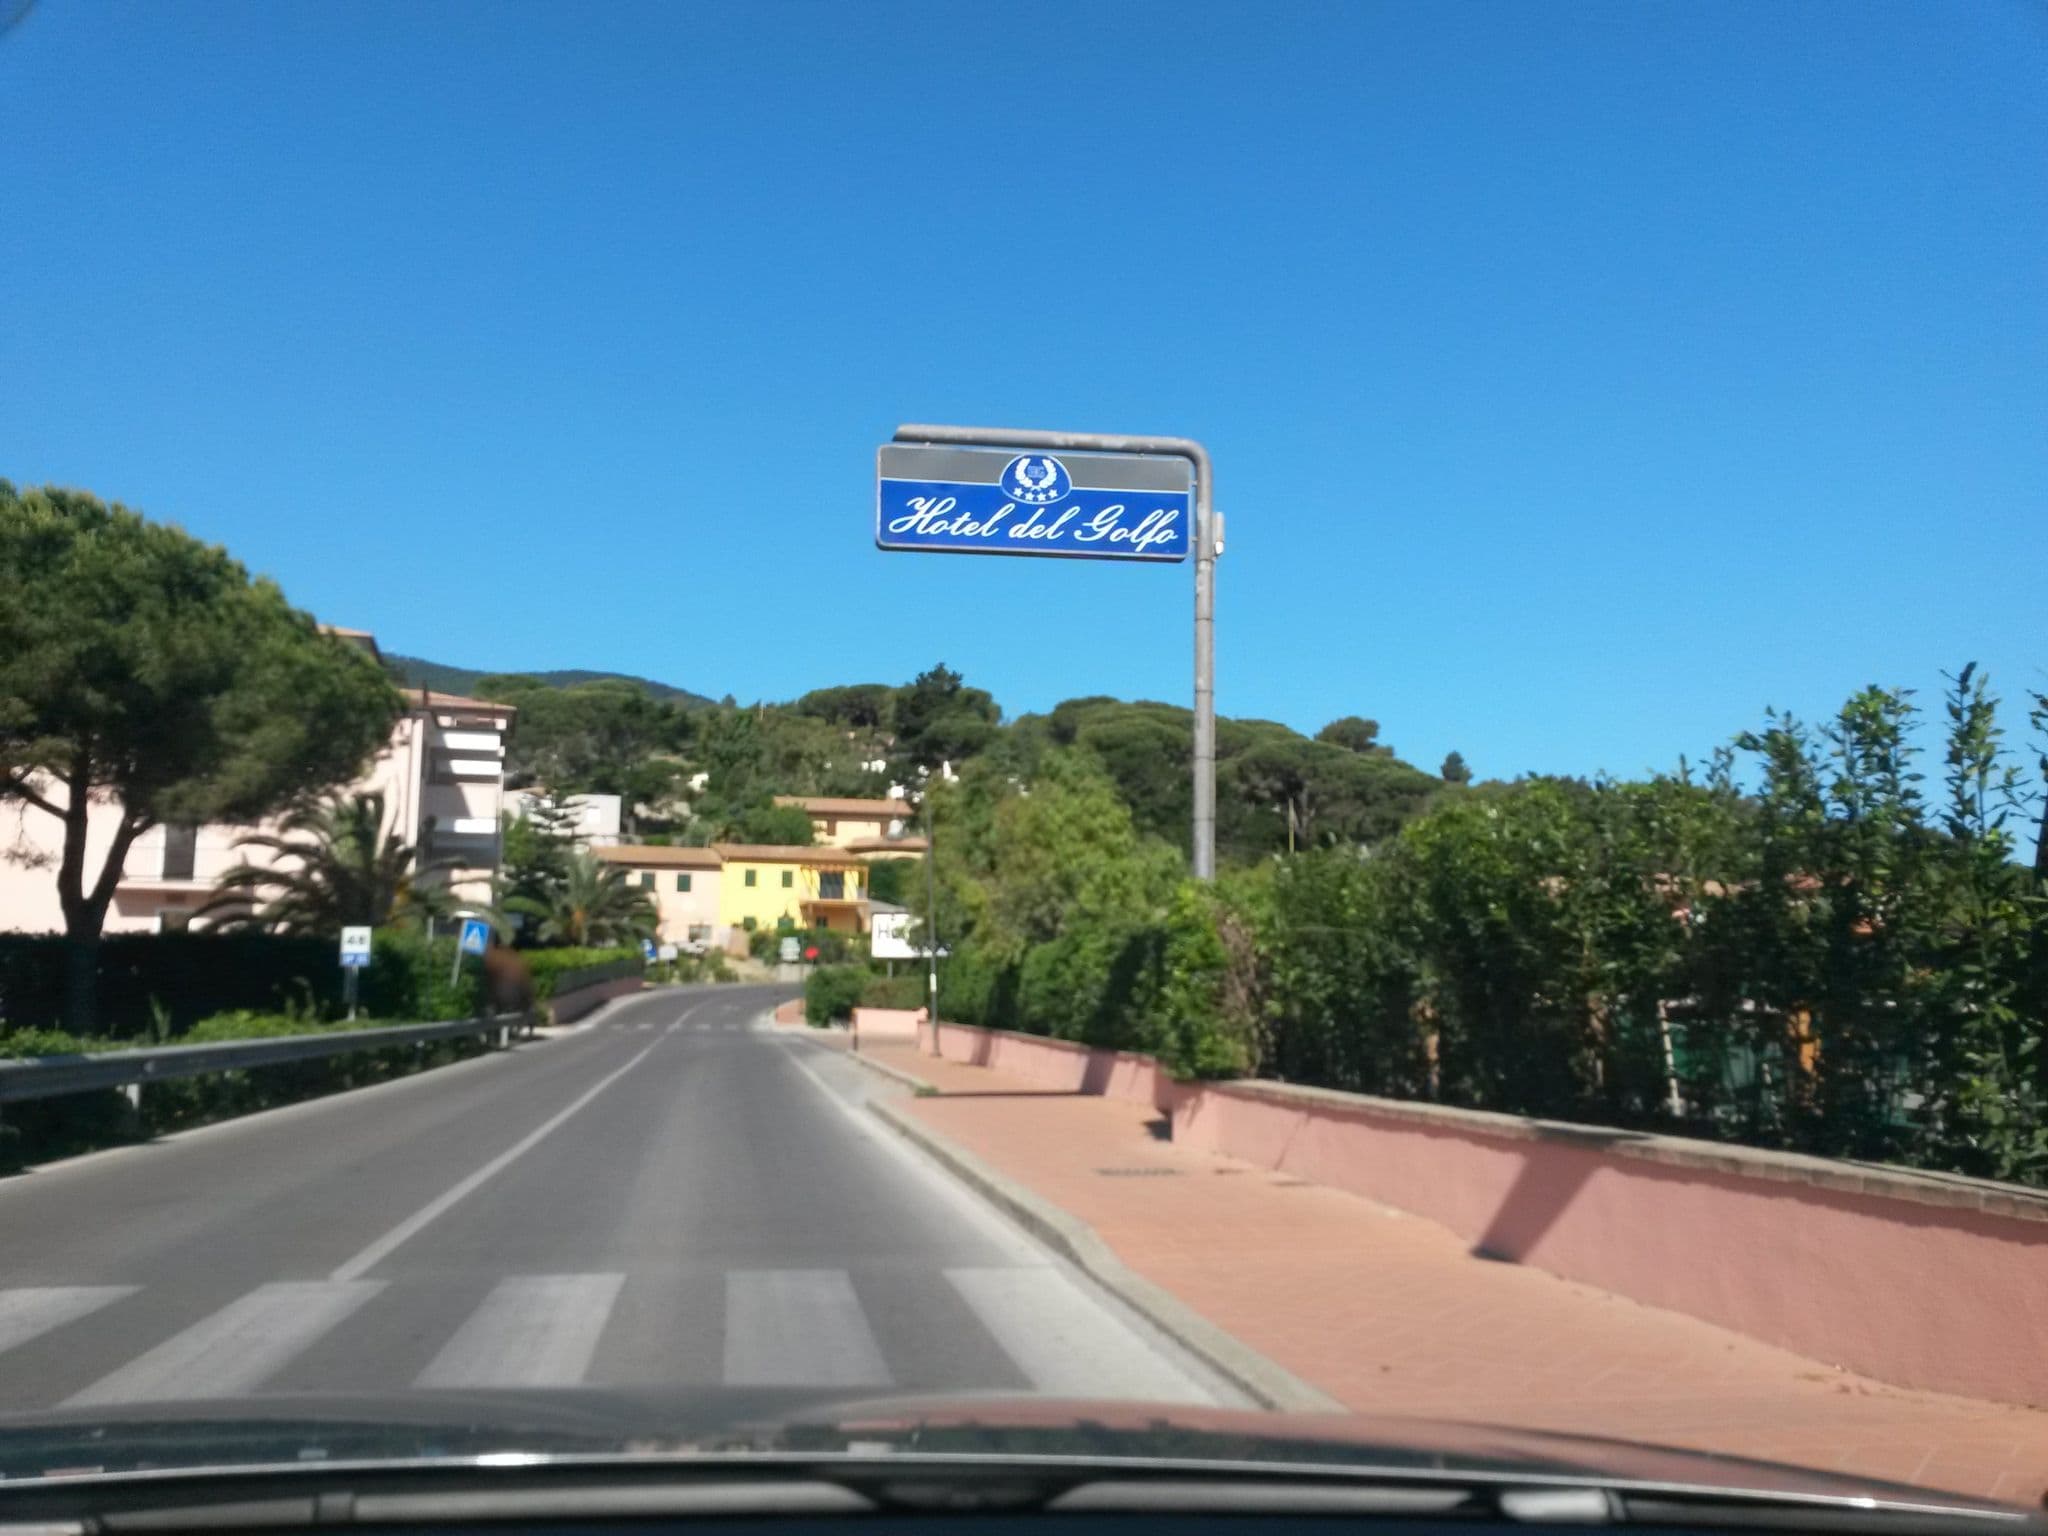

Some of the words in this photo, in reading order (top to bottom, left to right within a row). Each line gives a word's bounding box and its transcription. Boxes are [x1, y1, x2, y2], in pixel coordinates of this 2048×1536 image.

[889, 496, 1015, 536] Hotel
[1008, 505, 1080, 540] del
[1074, 504, 1179, 553] Golfo
